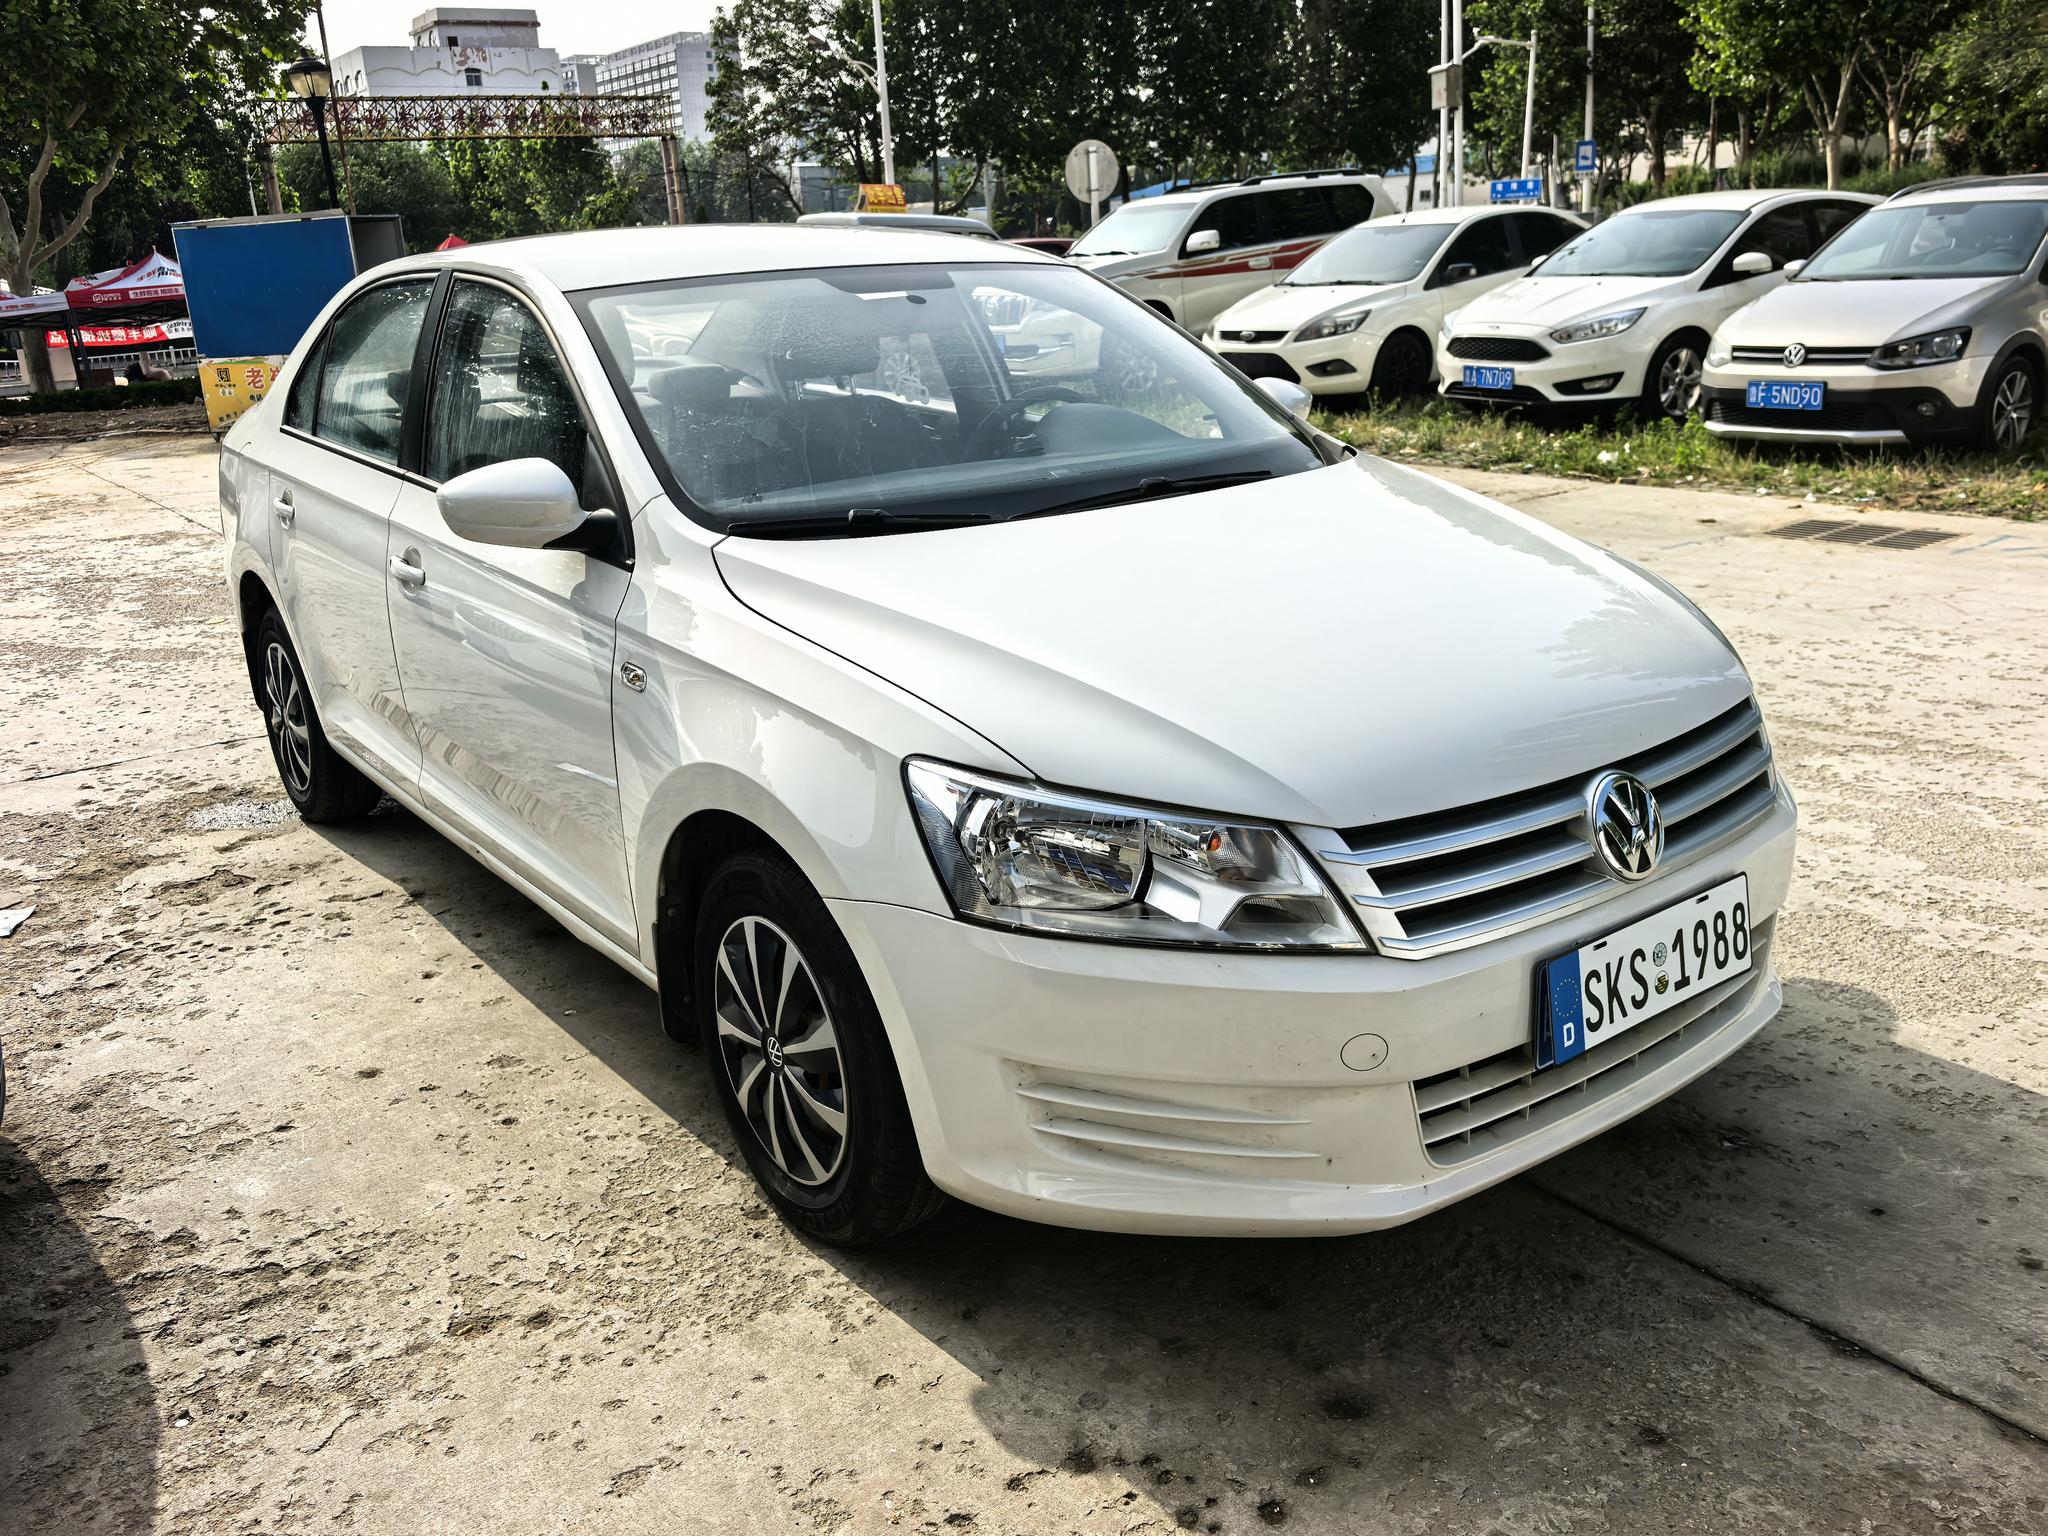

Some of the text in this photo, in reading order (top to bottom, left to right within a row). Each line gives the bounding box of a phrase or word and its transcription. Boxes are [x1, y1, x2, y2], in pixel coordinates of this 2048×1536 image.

[1584, 947, 1649, 1033] SKS
[1672, 901, 1748, 993] 1988
[1563, 1021, 1575, 1047] D
